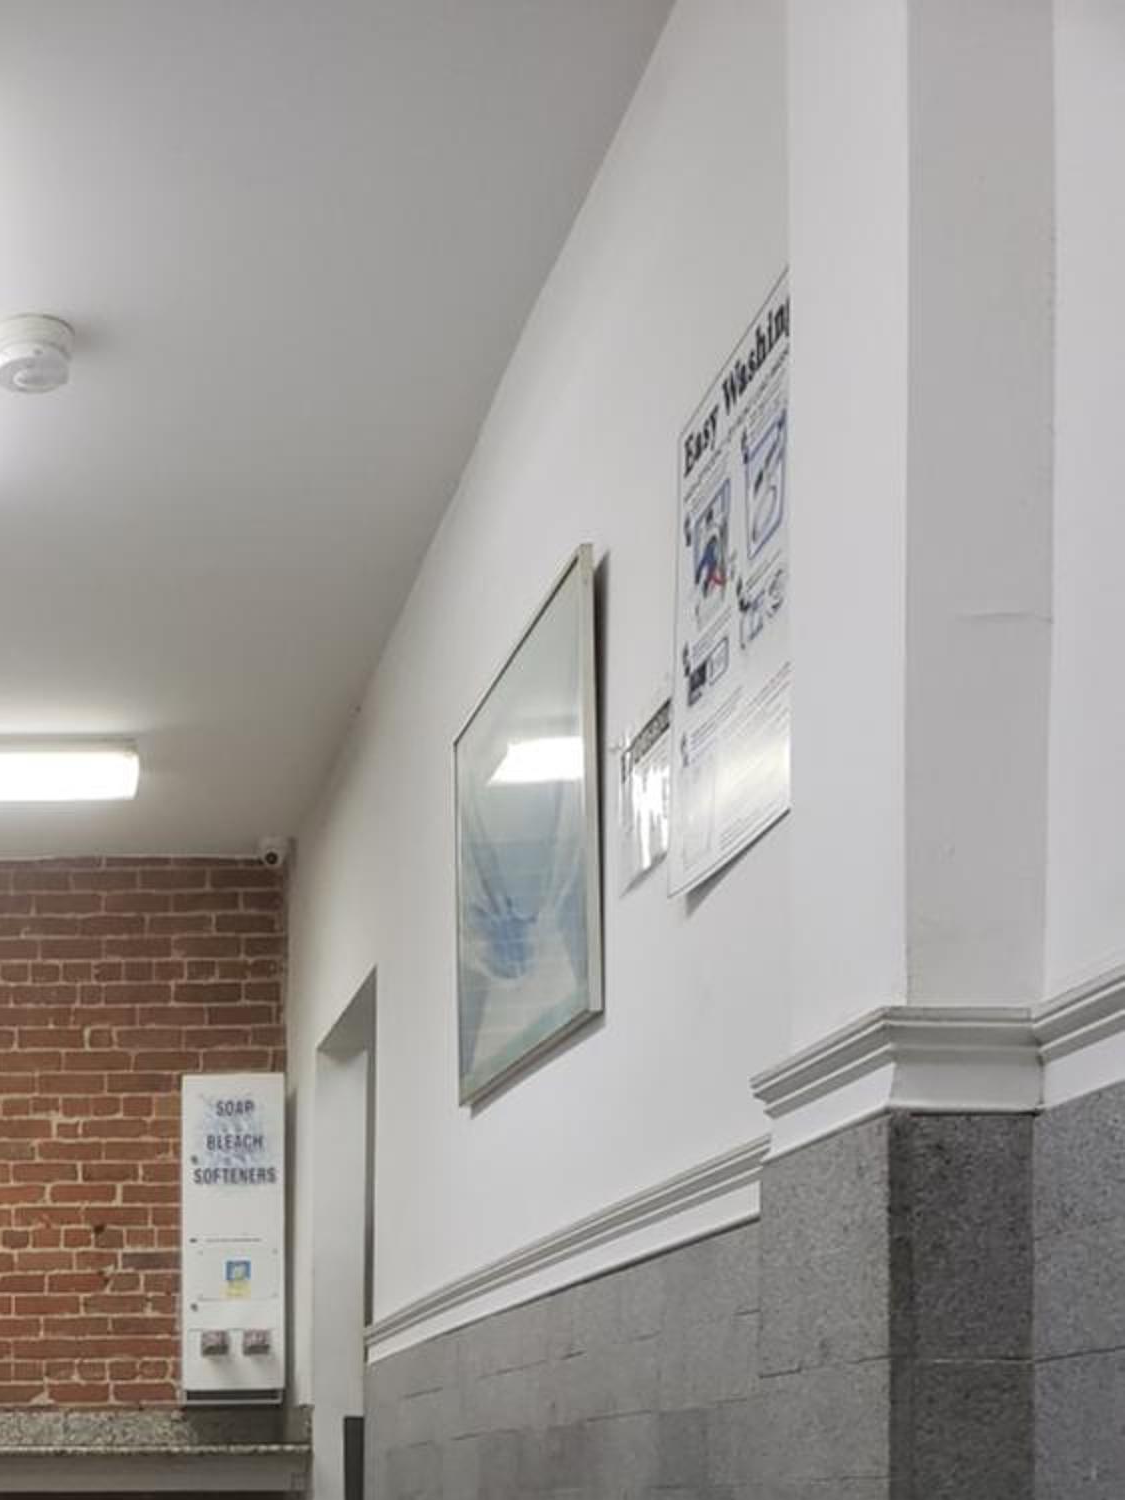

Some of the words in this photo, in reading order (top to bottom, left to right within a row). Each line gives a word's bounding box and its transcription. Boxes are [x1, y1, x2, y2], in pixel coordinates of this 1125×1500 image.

[684, 405, 719, 476] Easy
[215, 1099, 255, 1117] SOAP
[206, 1134, 264, 1151] BLEACH
[193, 1167, 277, 1185] SOFTENERS
